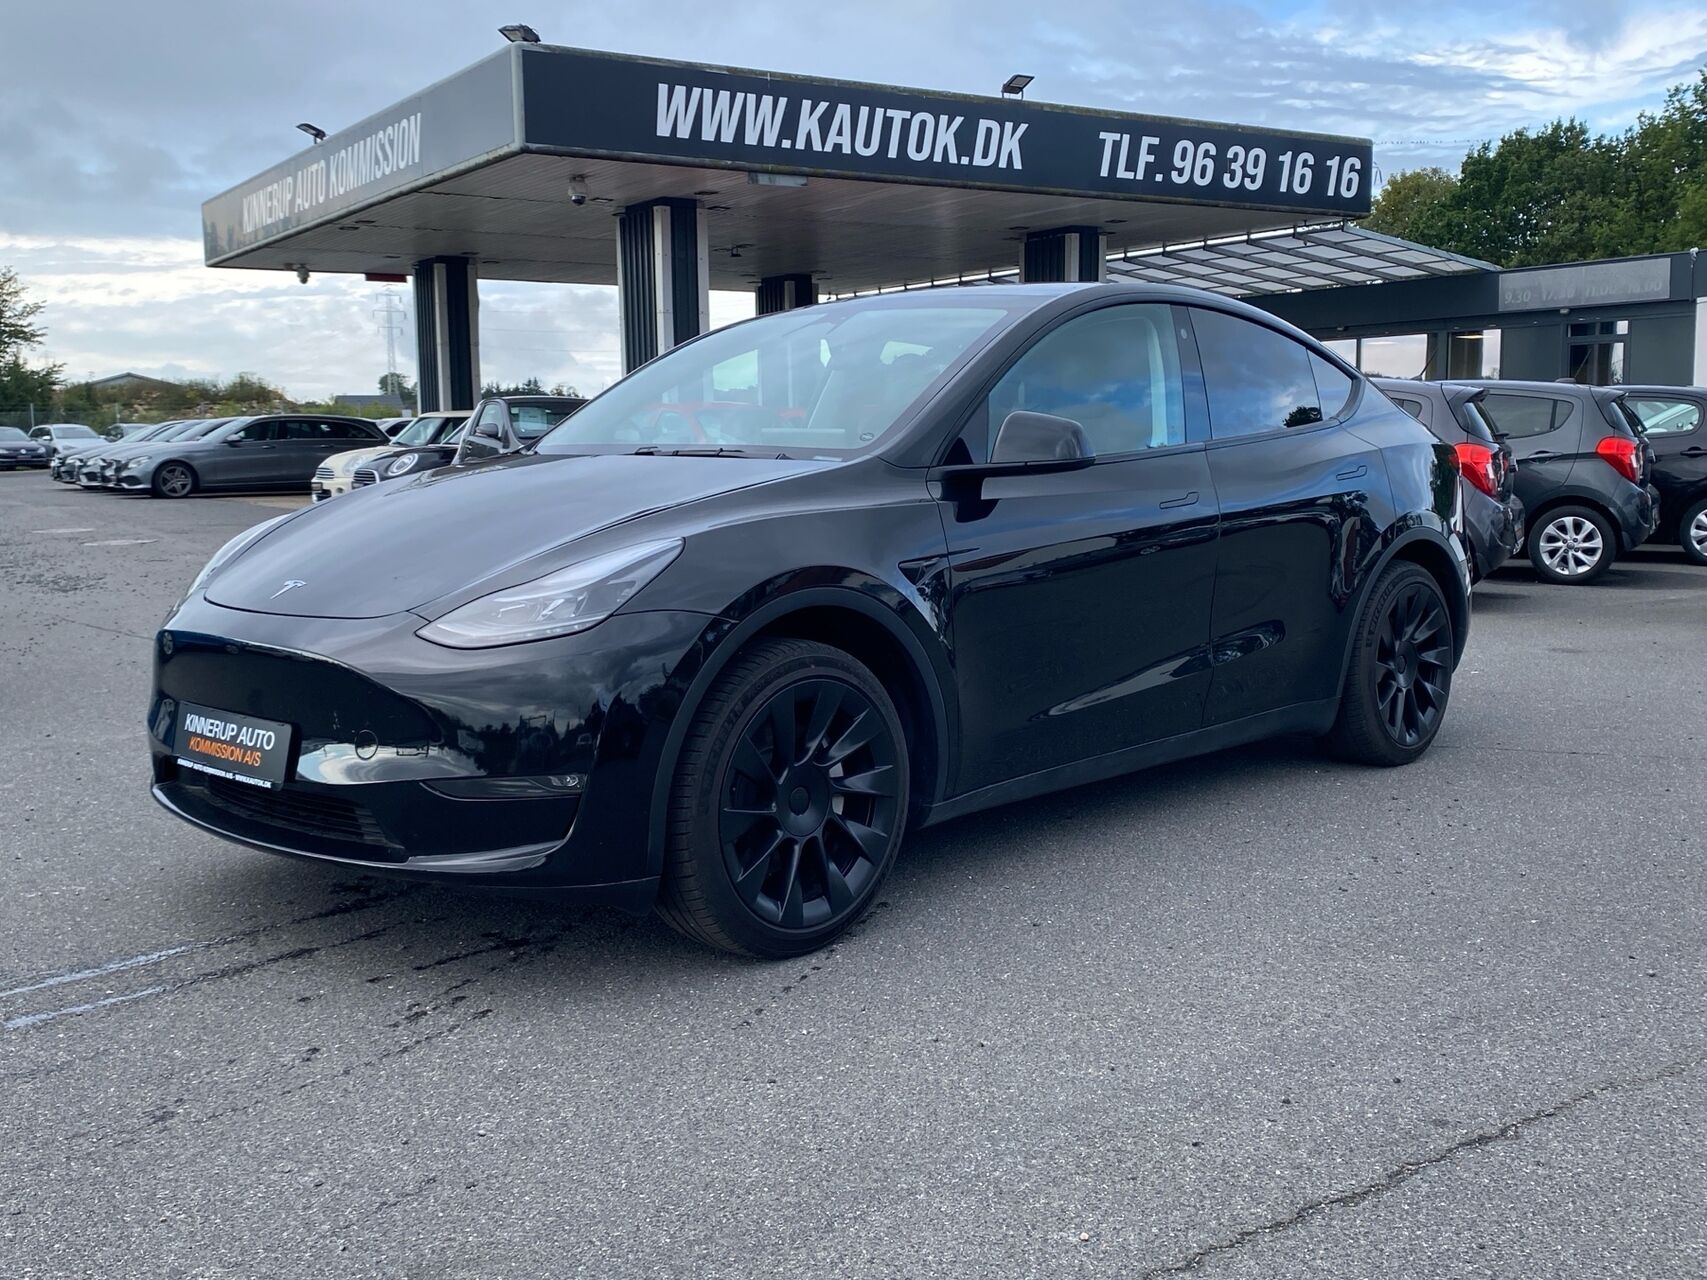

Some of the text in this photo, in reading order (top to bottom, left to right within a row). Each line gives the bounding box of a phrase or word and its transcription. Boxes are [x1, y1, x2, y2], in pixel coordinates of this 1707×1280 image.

[656, 82, 1029, 171] WWW.KAUTOK.DK
[242, 112, 421, 234] KINNERUP AUTO KOMMISSION
[1099, 131, 1361, 199] TLF. 96 39 16 16
[184, 713, 275, 750] KINNERUP AUTO
[188, 736, 262, 767] KOMMISSION A/S
